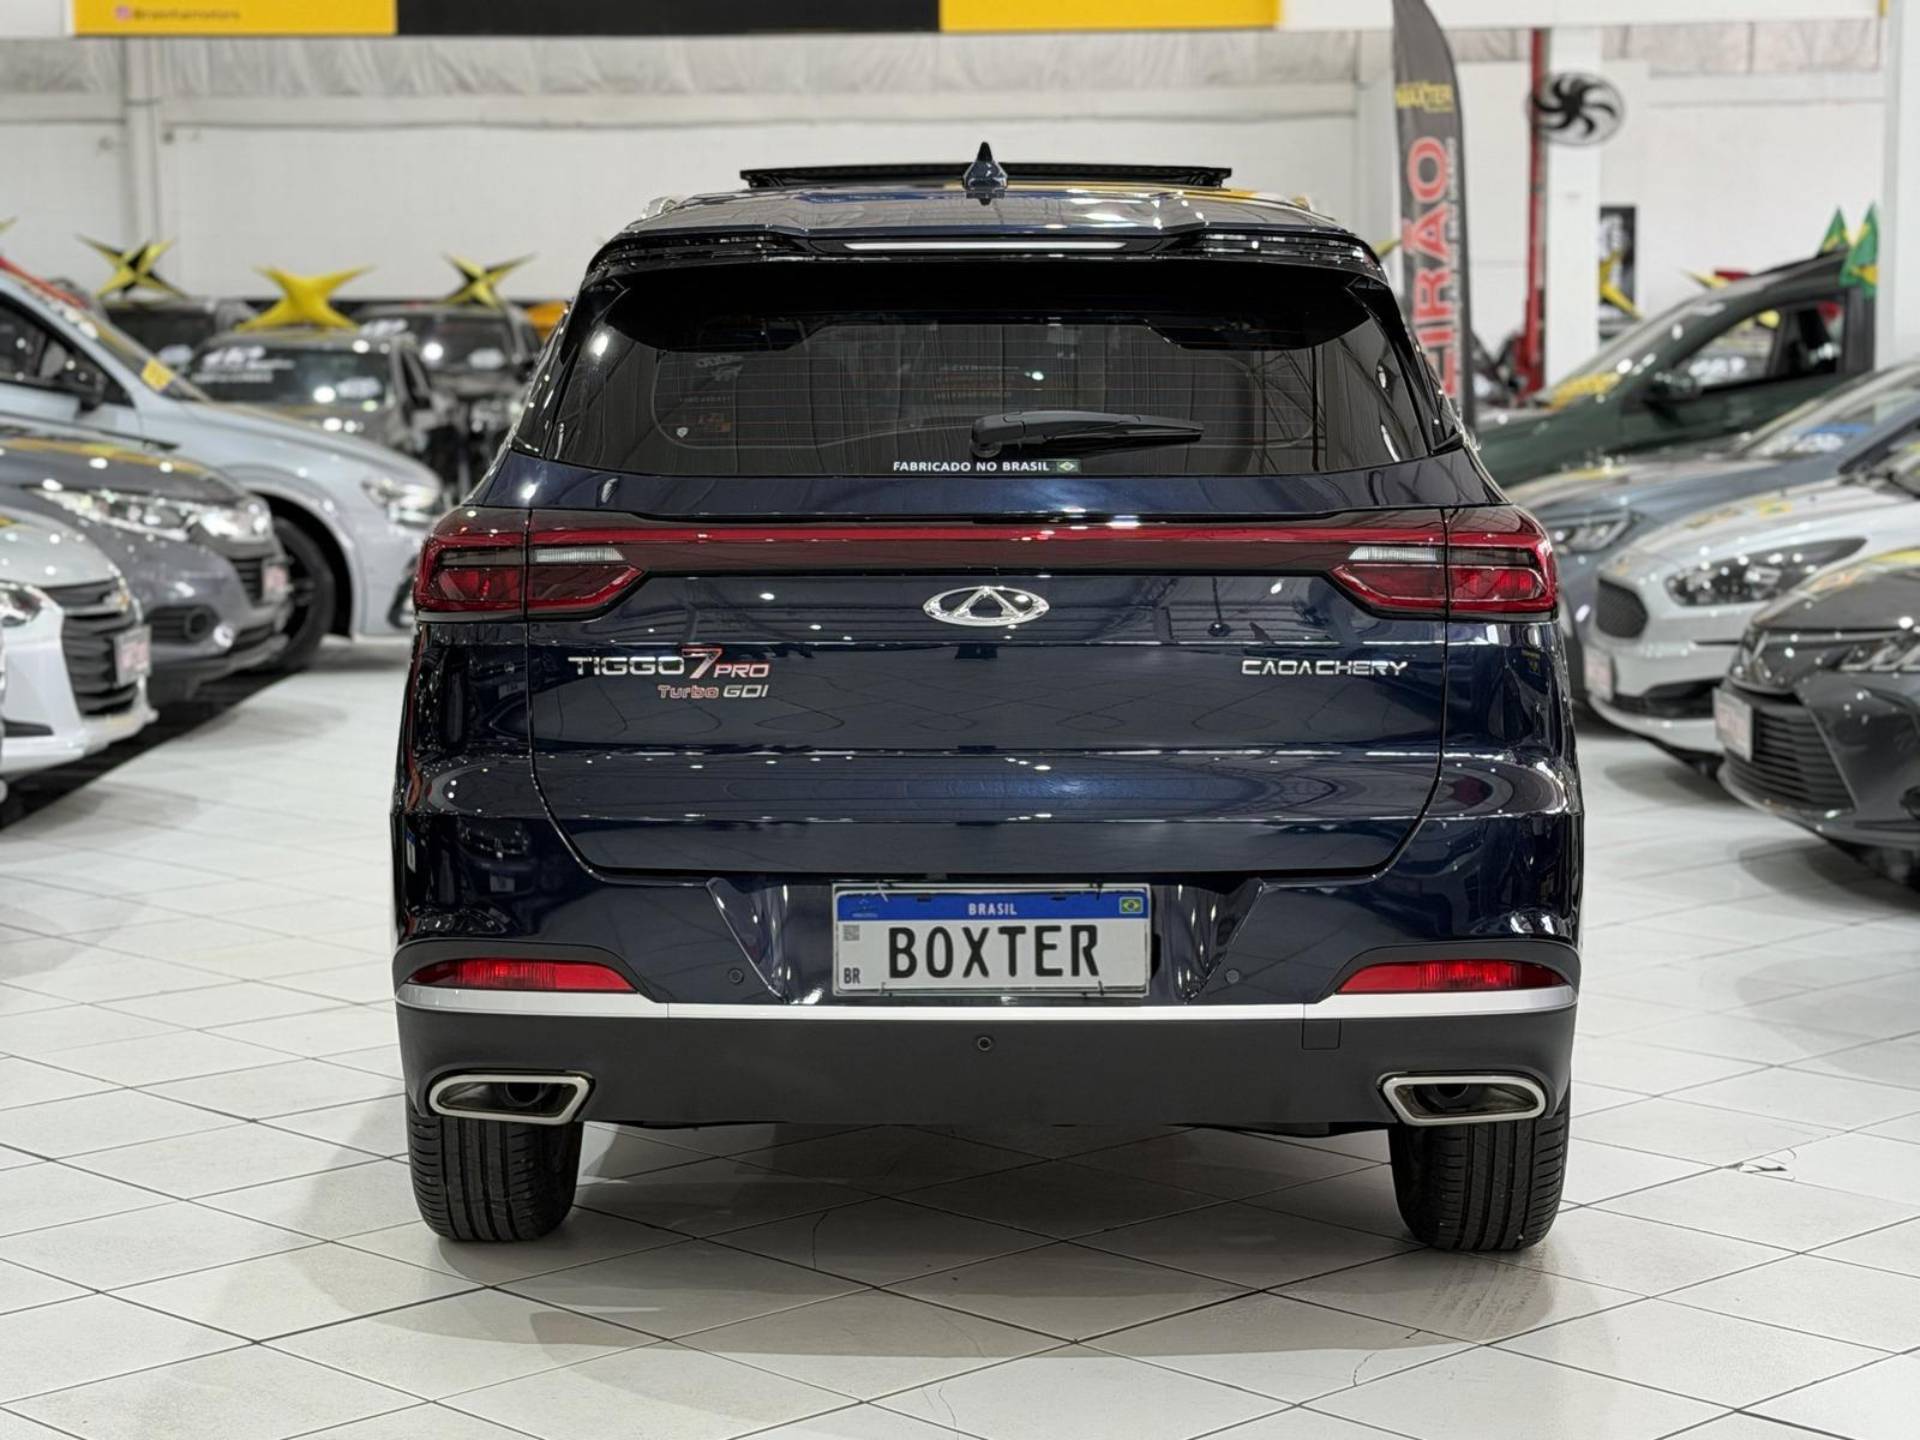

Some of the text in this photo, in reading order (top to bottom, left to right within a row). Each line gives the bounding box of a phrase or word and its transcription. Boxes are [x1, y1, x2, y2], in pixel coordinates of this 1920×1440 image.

[893, 461, 1050, 472] FABRICADO NO BRASIL
[567, 648, 770, 679] TIGGO 7 PRO
[657, 684, 769, 699] Turbo GDI
[968, 903, 1018, 916] BRASIL
[888, 924, 1099, 978] BOXTER
[843, 967, 861, 984] BR
